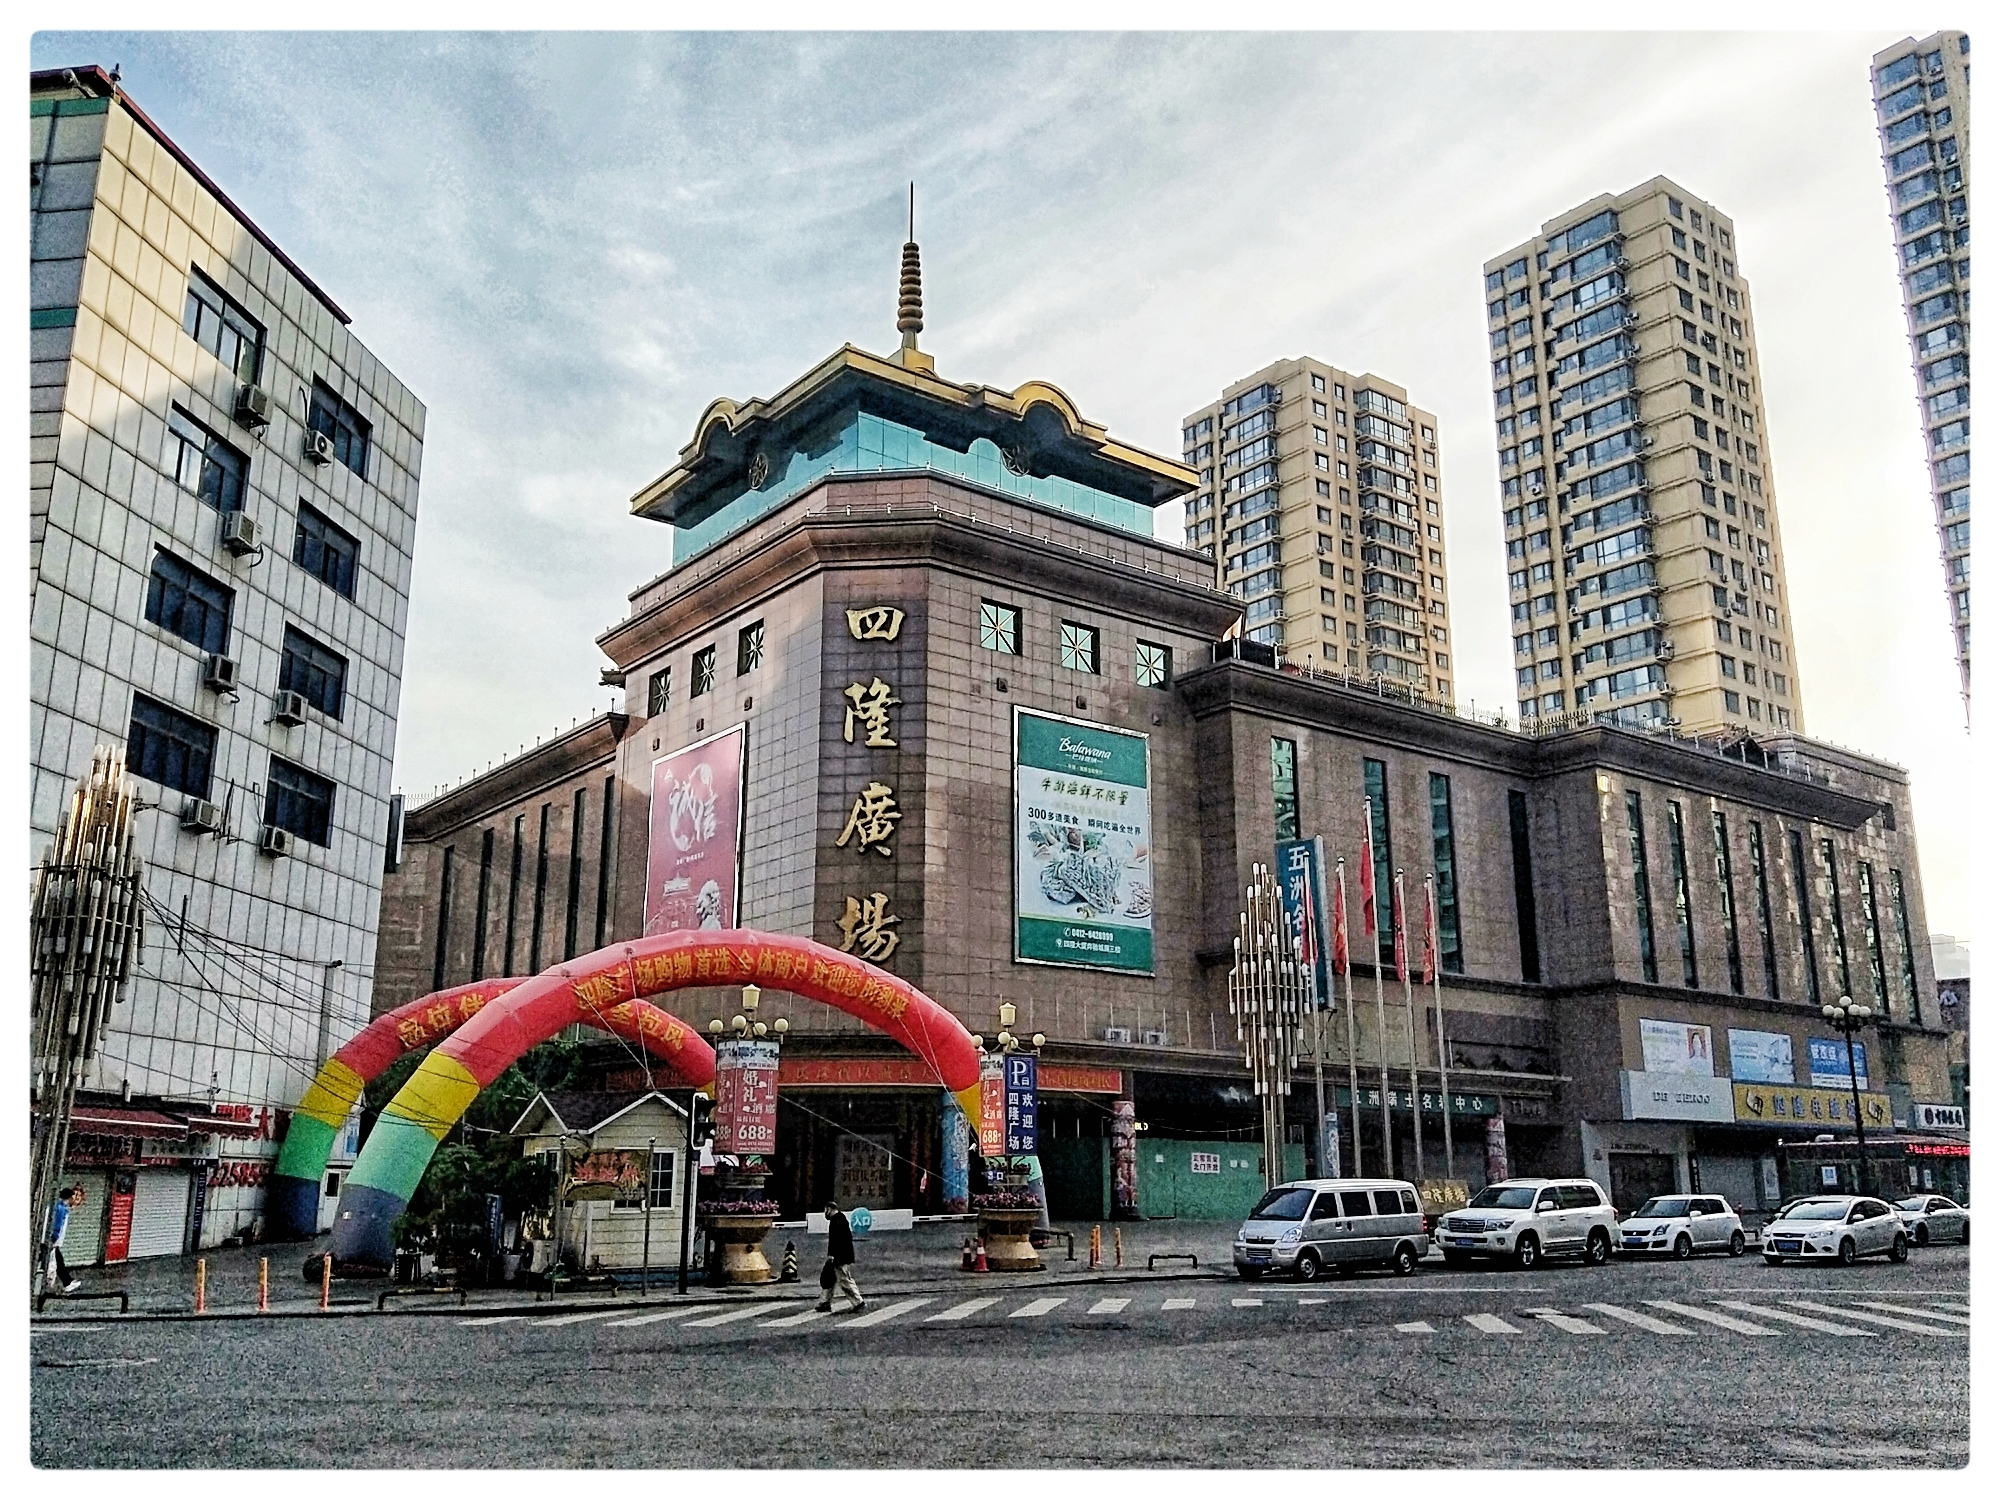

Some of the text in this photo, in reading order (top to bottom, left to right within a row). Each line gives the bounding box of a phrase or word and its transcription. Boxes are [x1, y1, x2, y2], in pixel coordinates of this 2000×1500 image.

[835, 605, 905, 962] 四隆廣場
[738, 1125, 766, 1140] 688
[982, 1129, 998, 1143] 688
[1008, 1092, 1020, 1150] 四隆广场
[1021, 1092, 1034, 1150] 欢迎您
[853, 1215, 870, 1226] 入口
